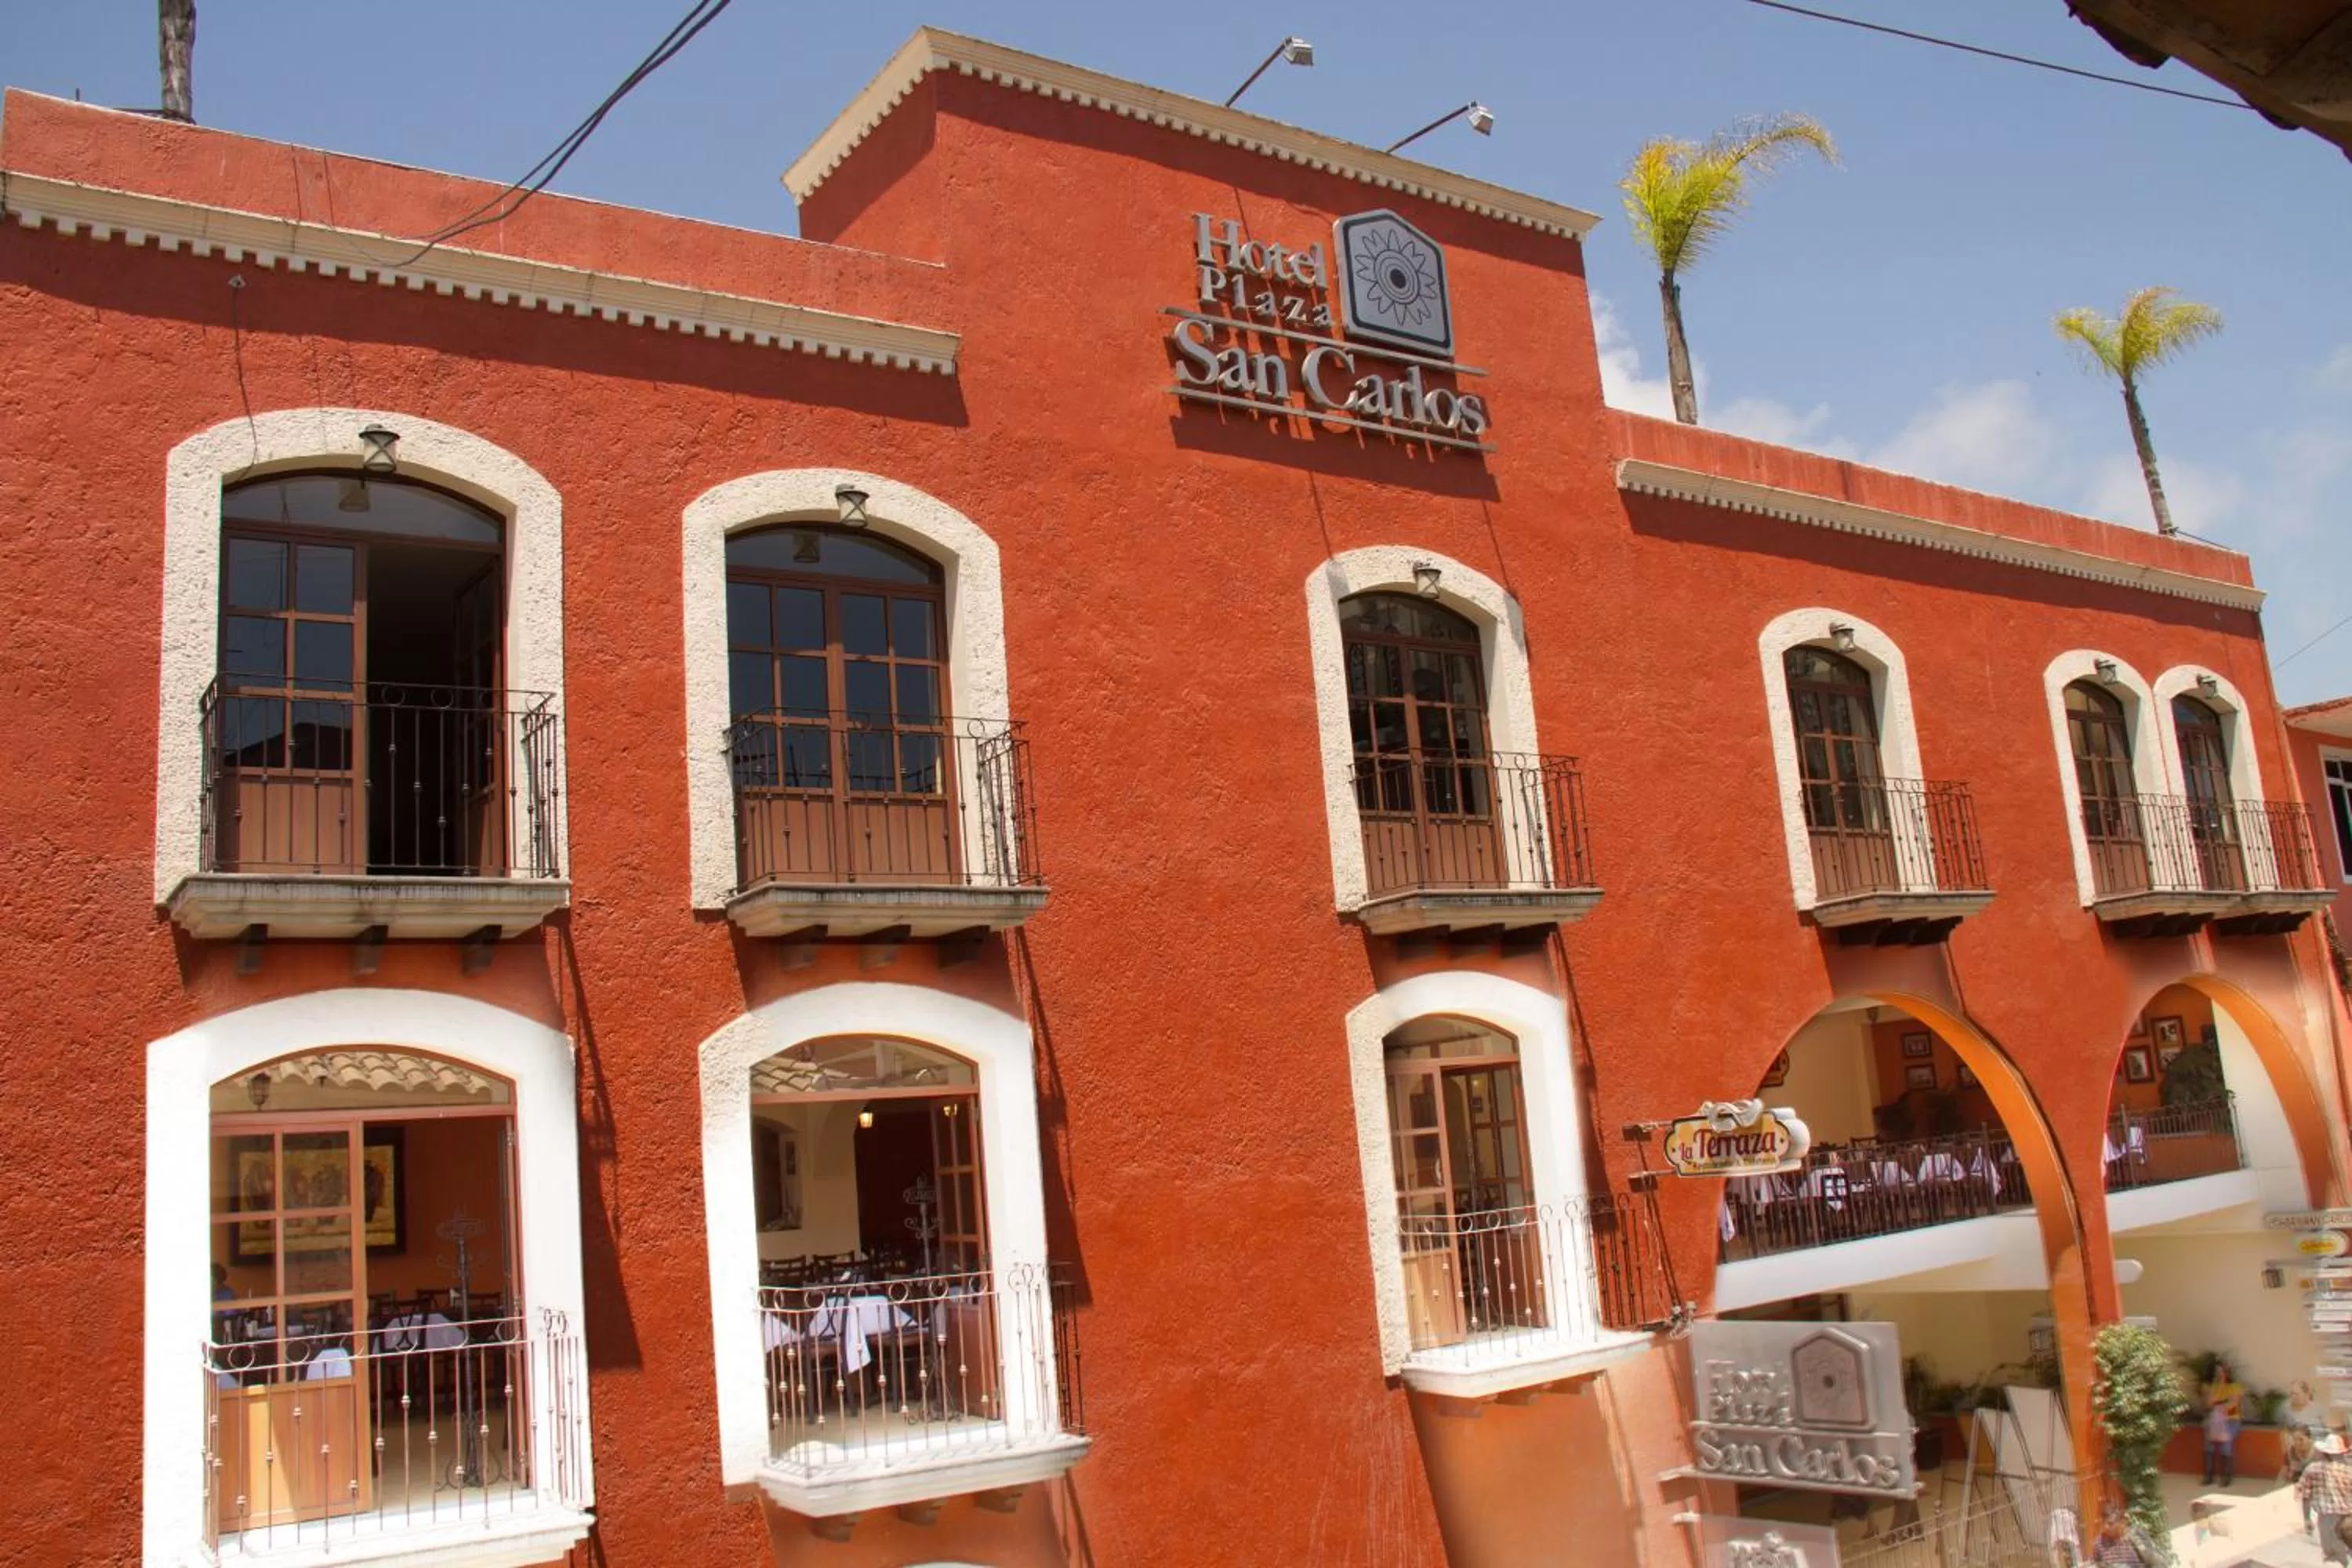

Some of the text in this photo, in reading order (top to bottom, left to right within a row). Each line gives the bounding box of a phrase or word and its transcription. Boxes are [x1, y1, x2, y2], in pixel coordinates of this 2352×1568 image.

[1192, 212, 1328, 289] Hotel
[1197, 266, 1334, 327] Plaza
[1174, 319, 1486, 434] San Carlos
[1693, 1128, 1777, 1158] Terraza
[1696, 1428, 1901, 1488] San Carlos
